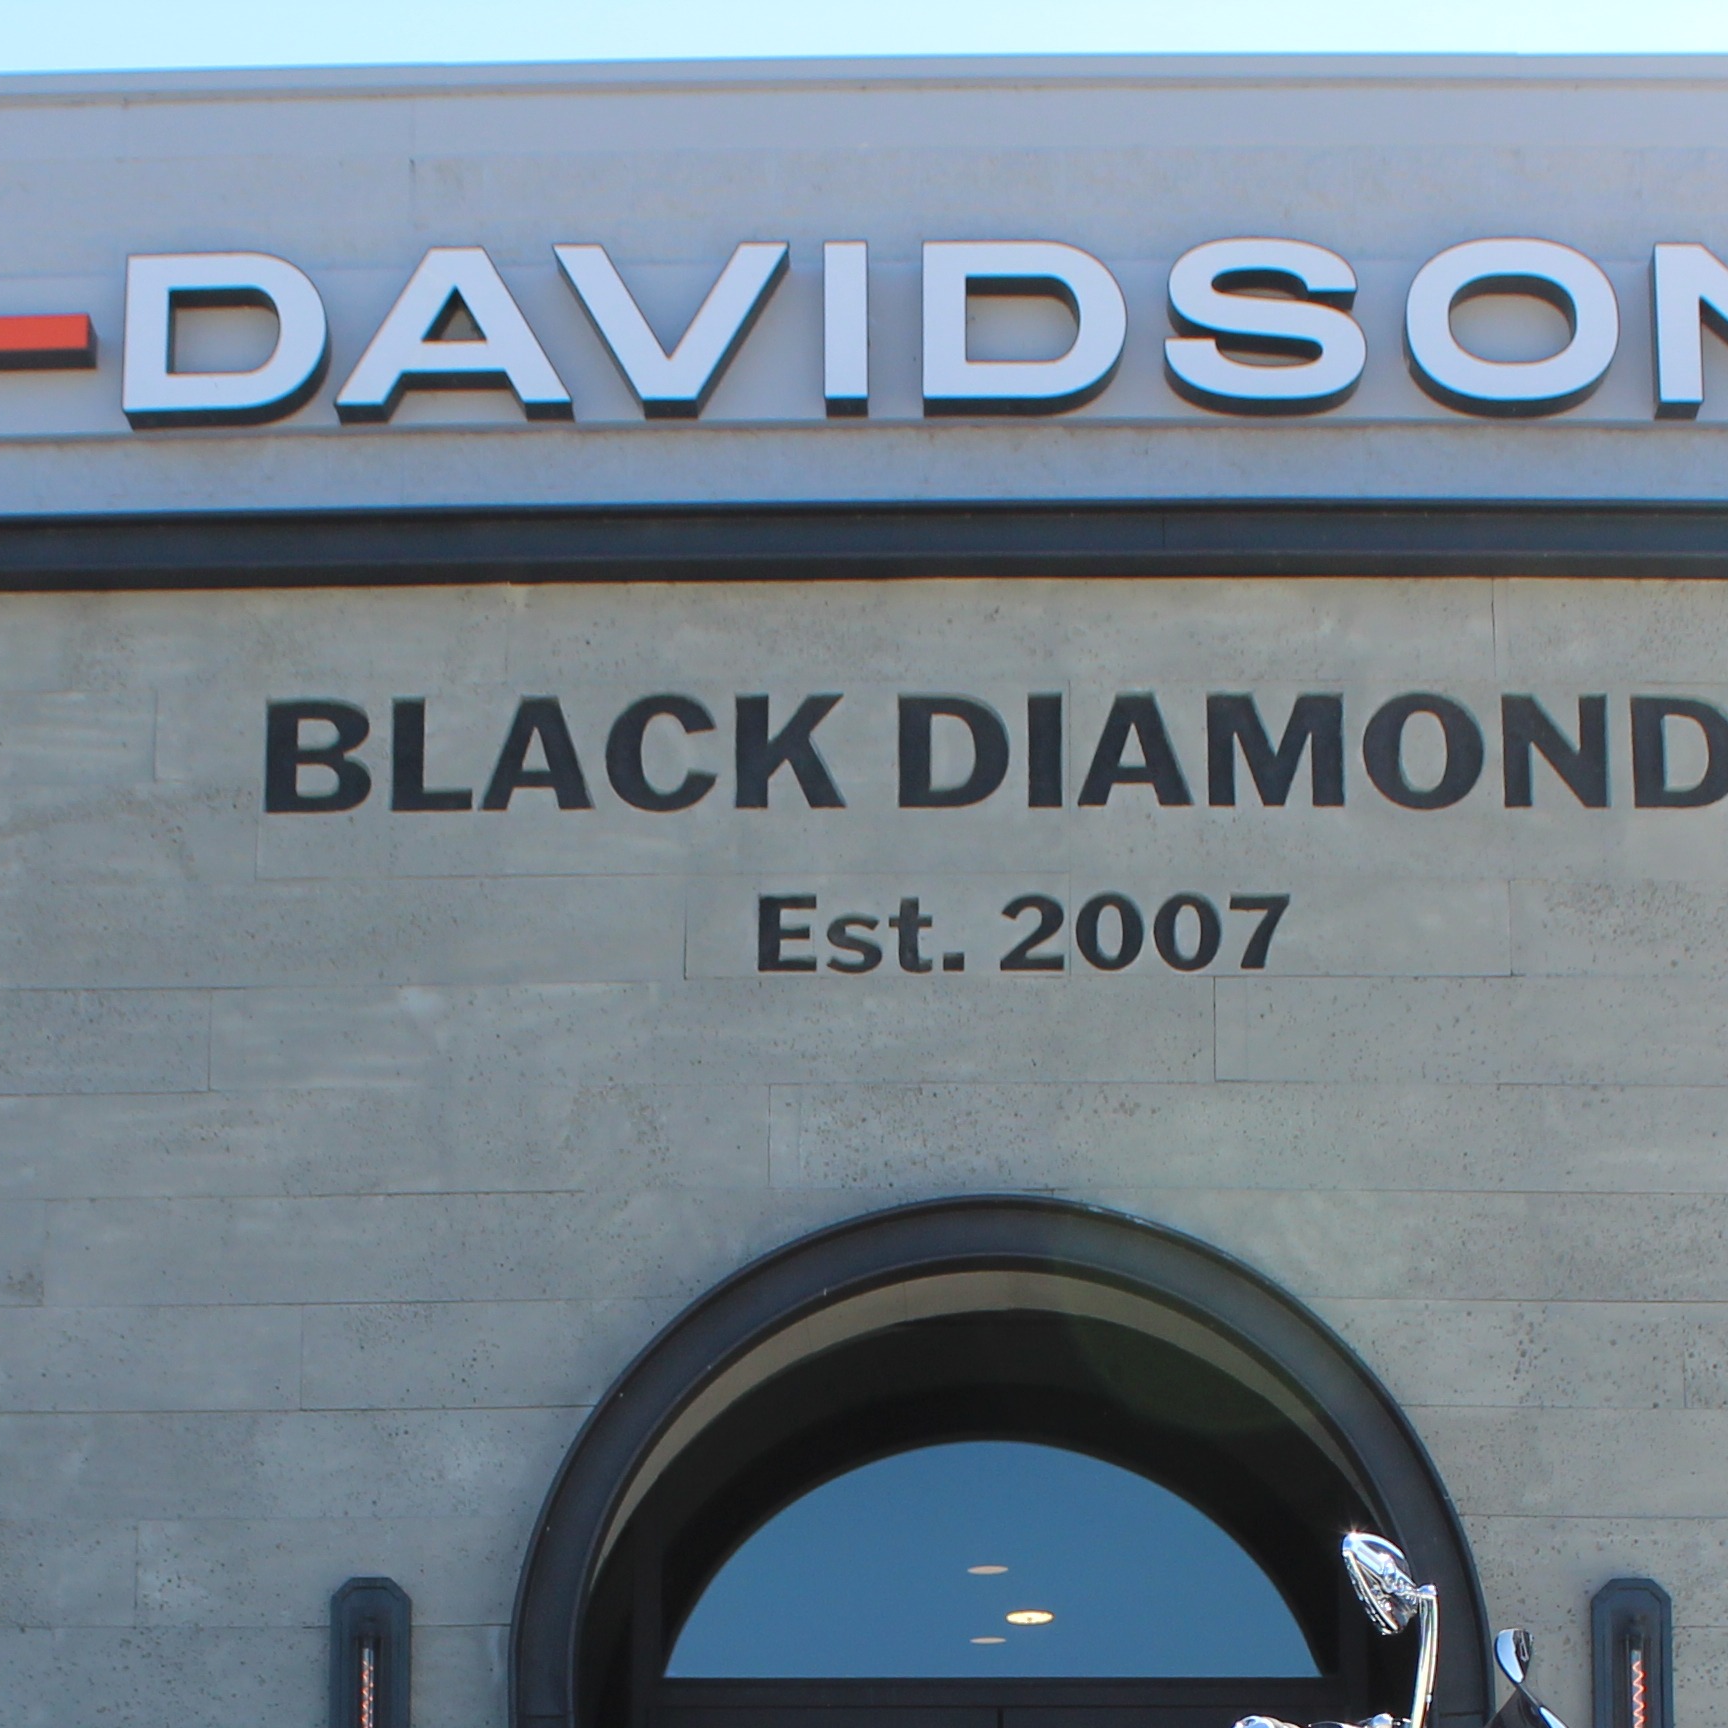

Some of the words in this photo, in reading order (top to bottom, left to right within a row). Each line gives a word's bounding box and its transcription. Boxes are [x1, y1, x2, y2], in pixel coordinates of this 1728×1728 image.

[264, 692, 848, 813] BLACK
[757, 894, 965, 974] Est.
[999, 892, 1291, 972] 2007
